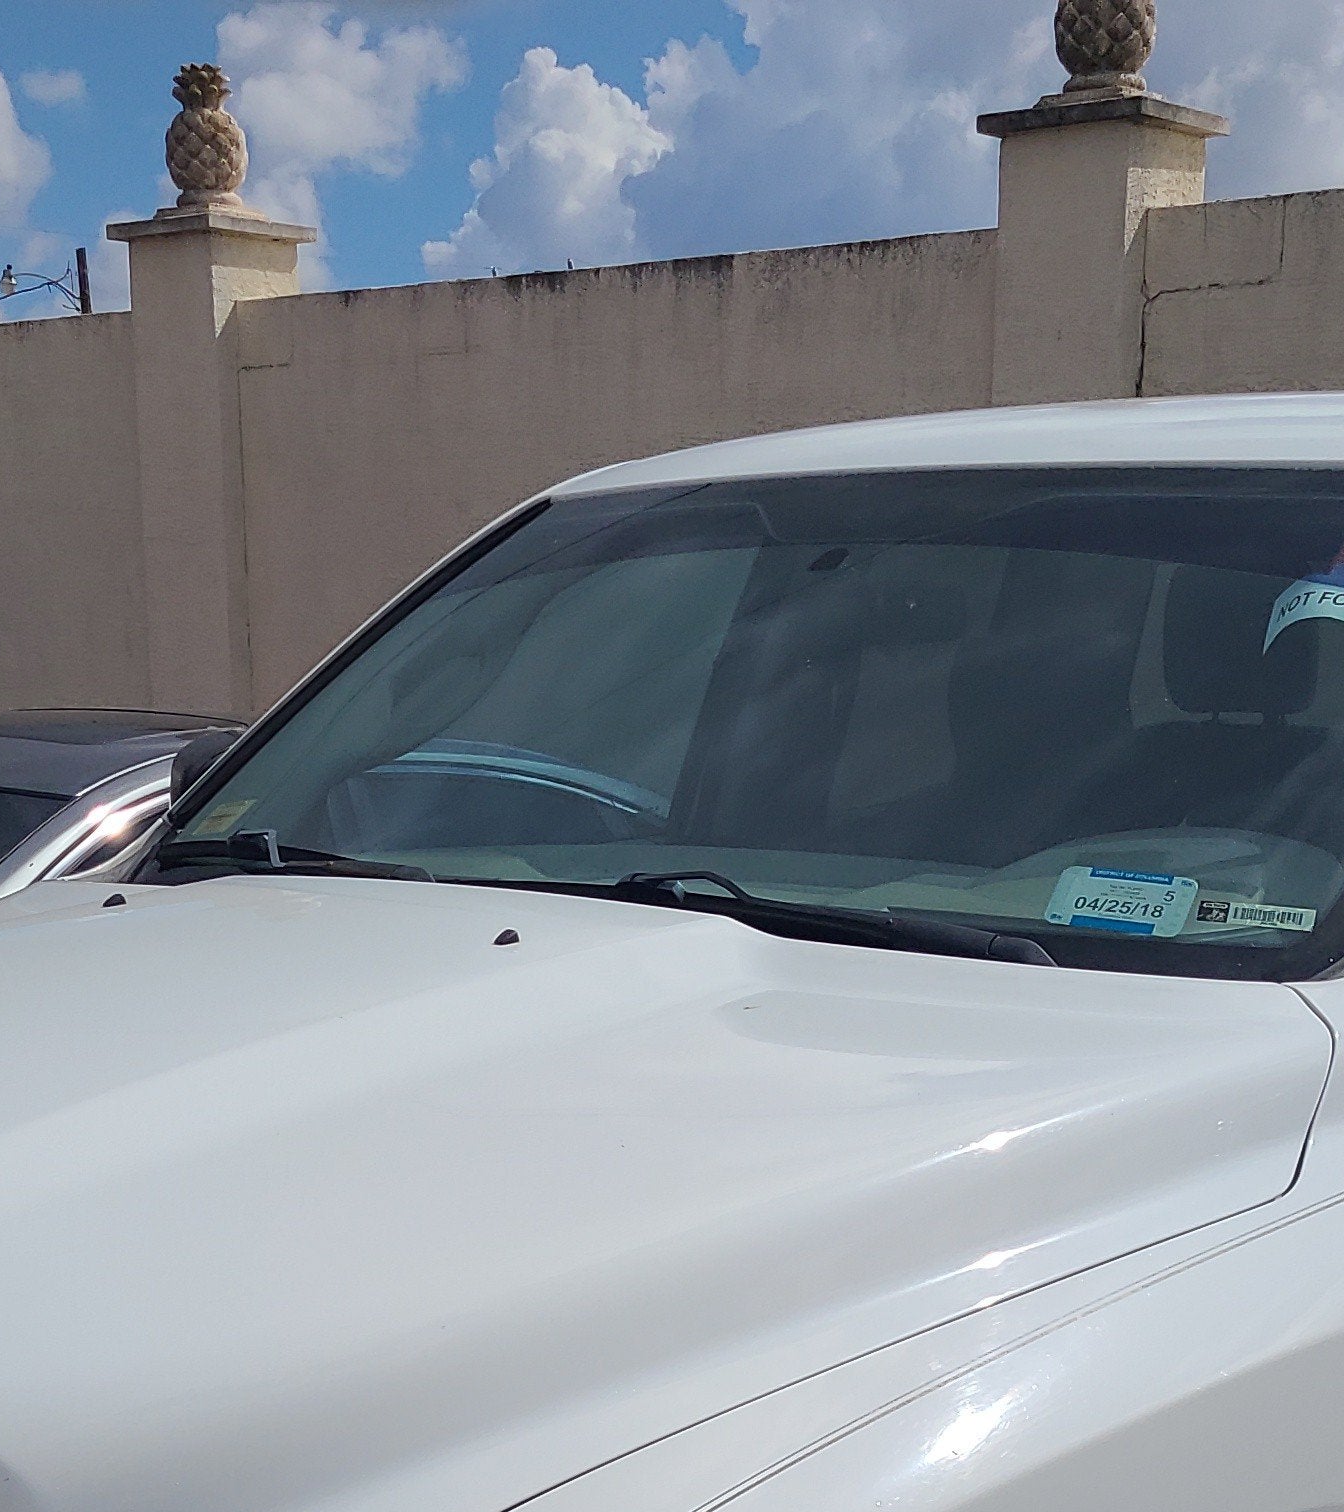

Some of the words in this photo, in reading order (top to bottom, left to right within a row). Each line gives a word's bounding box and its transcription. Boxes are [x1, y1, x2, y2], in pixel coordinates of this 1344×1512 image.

[1276, 590, 1318, 622] NOT
[1074, 896, 1164, 918] 04/25/18
[1162, 890, 1176, 902] 5
